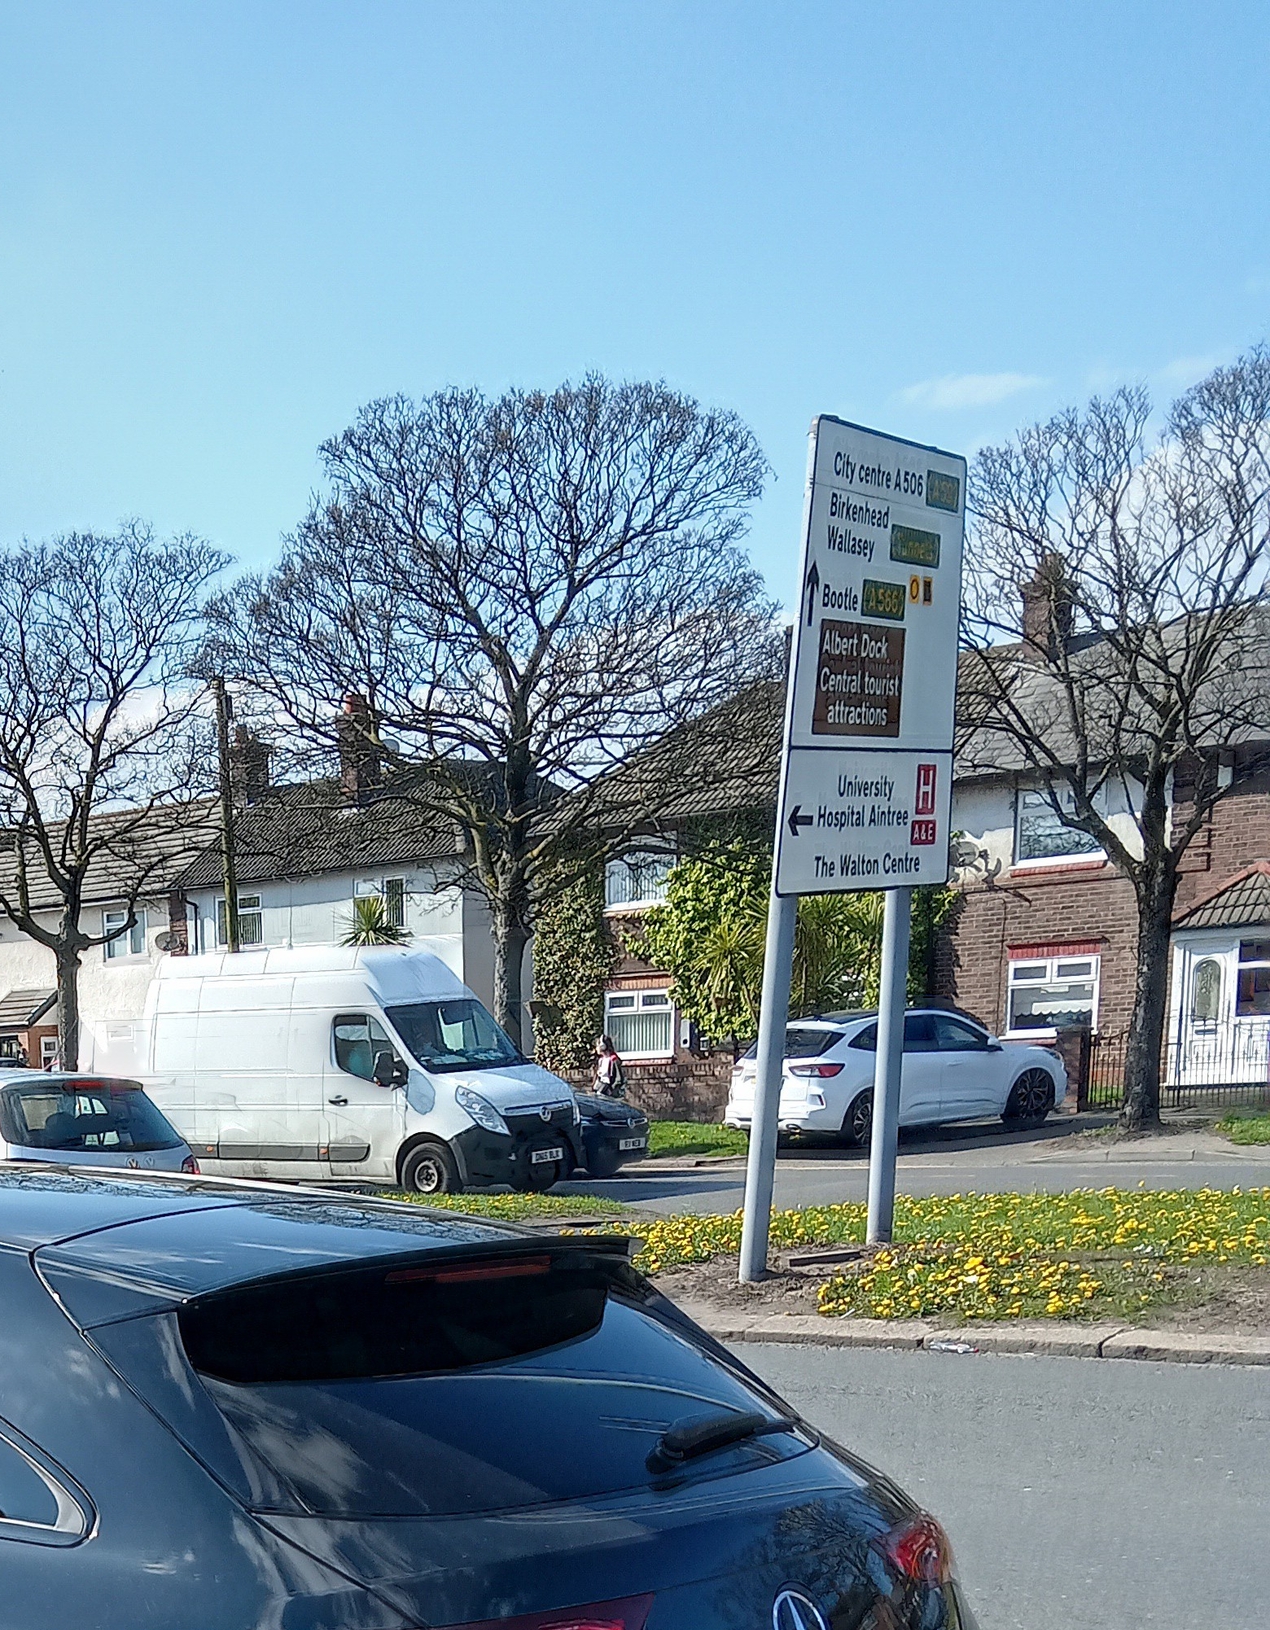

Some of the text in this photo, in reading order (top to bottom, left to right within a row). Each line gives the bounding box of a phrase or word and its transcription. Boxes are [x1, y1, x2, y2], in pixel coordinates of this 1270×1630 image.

[834, 451, 856, 484] City
[858, 463, 892, 490] centre
[830, 492, 890, 529] Birkenhead
[828, 525, 875, 562] Wallasey
[822, 584, 858, 612] Bootle
[823, 630, 888, 659] Albert Dock
[820, 667, 900, 696] Central tourist
[827, 705, 888, 726] attractions
[838, 775, 894, 800] University
[918, 769, 934, 810] H
[817, 804, 908, 832] Hospital Aintree
[913, 825, 934, 844] A&E
[814, 852, 920, 878] The Walton Centre
